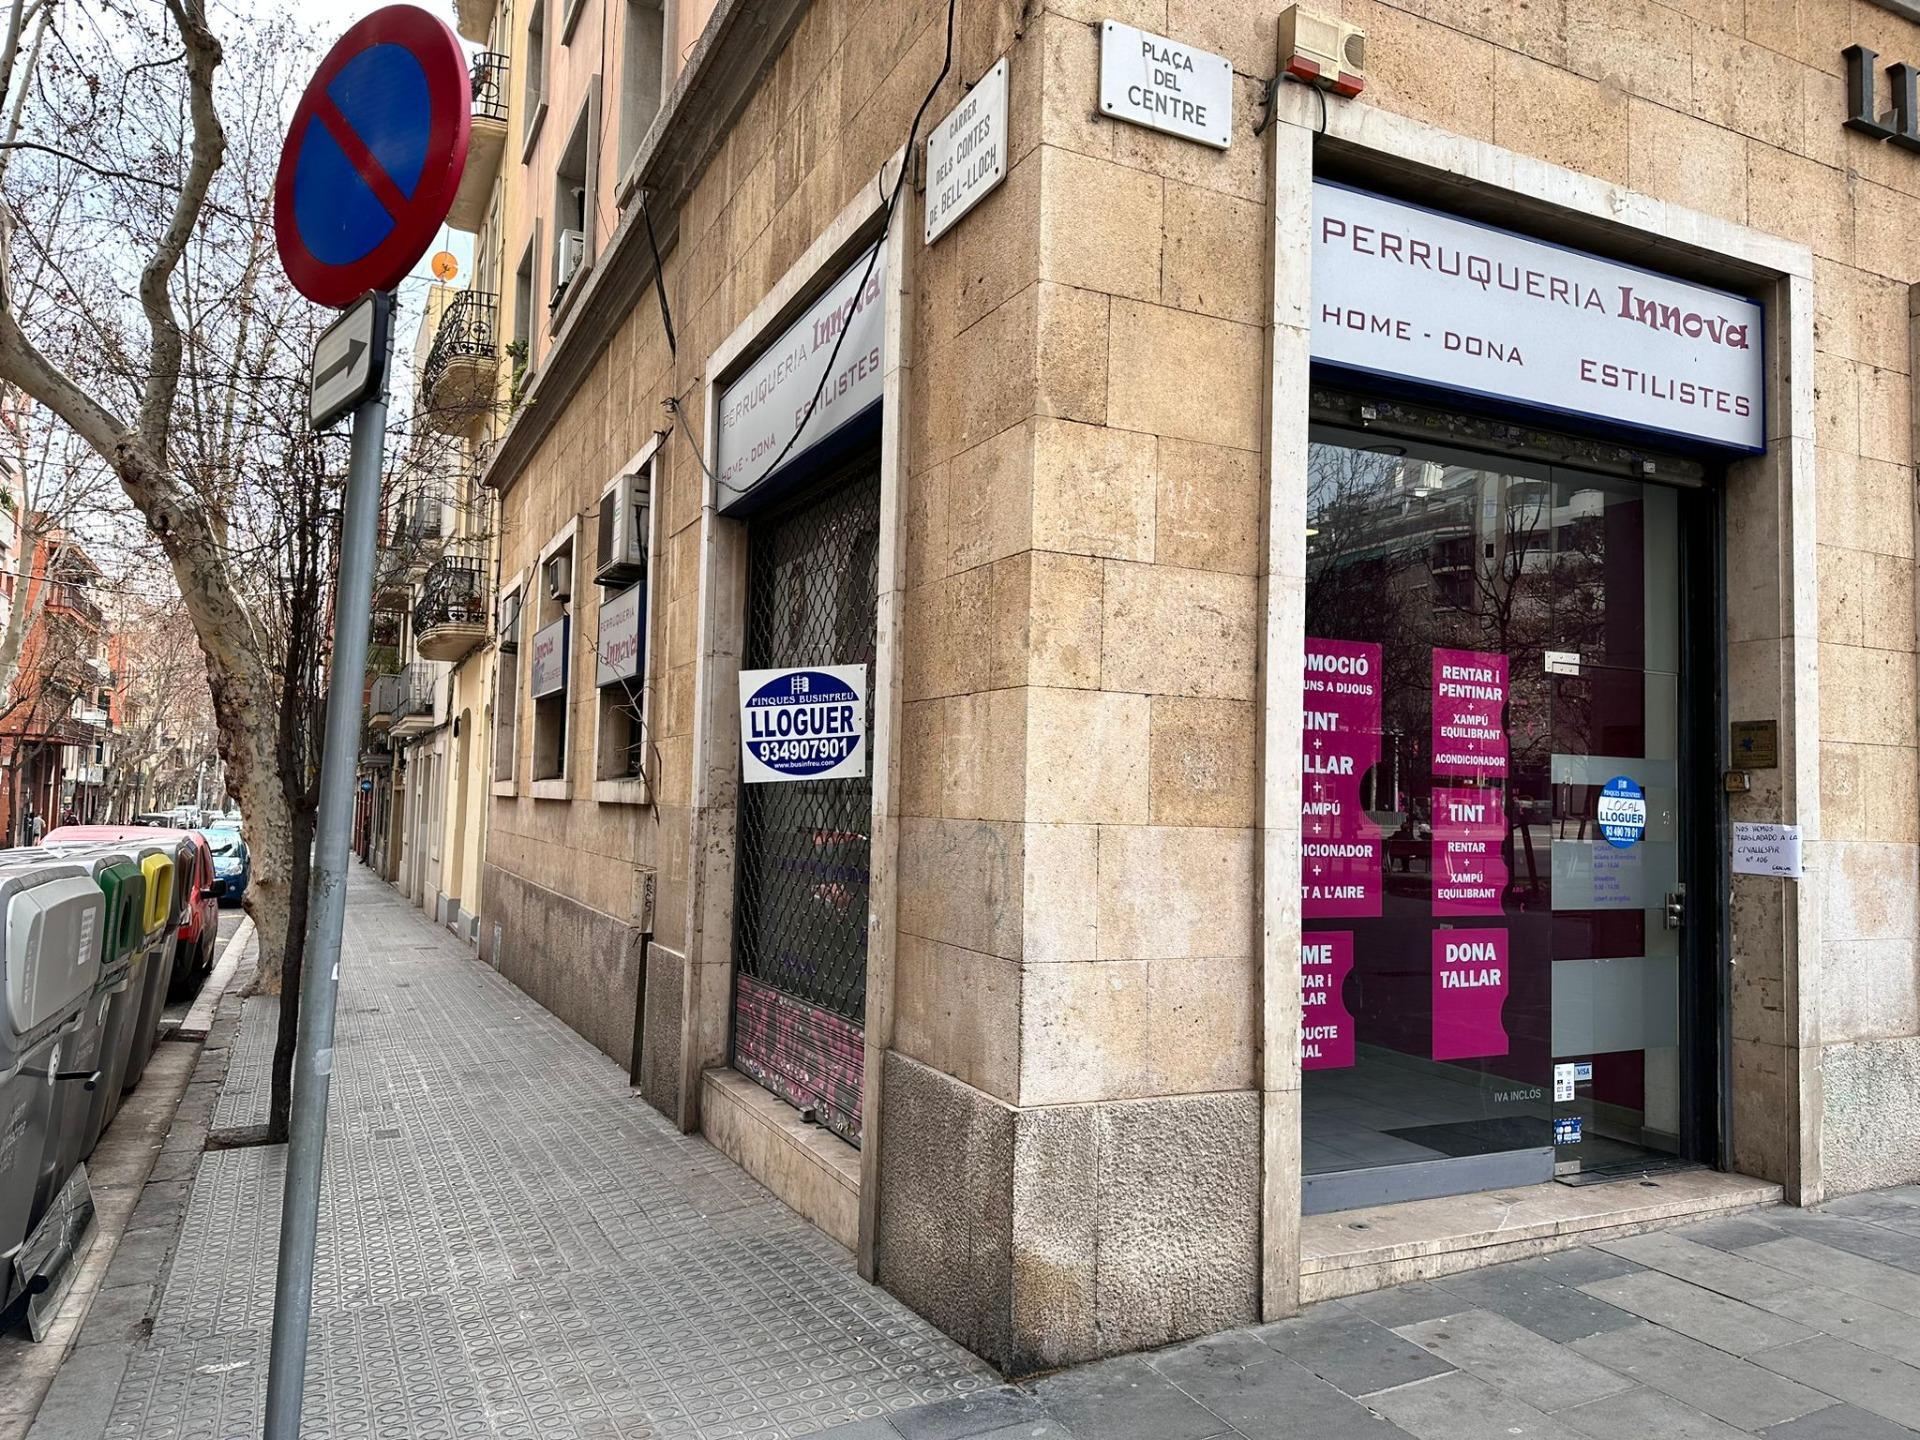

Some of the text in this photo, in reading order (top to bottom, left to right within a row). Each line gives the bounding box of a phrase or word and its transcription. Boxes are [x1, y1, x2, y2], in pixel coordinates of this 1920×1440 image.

[1141, 41, 1194, 73] PLAÇA
[1154, 69, 1182, 92] DEL
[1128, 85, 1207, 127] CENTRE
[949, 98, 977, 139] CARRER
[935, 114, 991, 186] DELS COMTES
[929, 143, 997, 226] DE BELL-LLOCH
[1322, 216, 1750, 350] PERRUQUERIA Innova
[1322, 303, 1411, 341] HOME
[1444, 331, 1523, 366] DONA
[722, 268, 881, 433] PERRUQUERIA Innova
[794, 346, 880, 429] ESTILISTES
[1580, 358, 1751, 417] ESTILISTES
[721, 458, 743, 482] HOME
[751, 432, 776, 461] DONA
[1442, 665, 1493, 683] RENTAR
[1326, 681, 1334, 692] A
[1336, 682, 1373, 696] DIJOUS
[1439, 683, 1502, 701] PENTINAR
[752, 692, 854, 706] FINQUES BUSINFREU
[751, 705, 854, 738] LLOGUER
[1453, 713, 1488, 726] XAMPÚ
[1441, 726, 1501, 740] EQUILIBRANT
[760, 738, 848, 762] 934907901
[1435, 753, 1506, 767] ACONDICIONADOR
[1448, 804, 1485, 823] TINT
[1607, 800, 1641, 812] LOCAL
[1600, 811, 1644, 824] LLOGUER
[1447, 842, 1486, 853] RENTAR
[1450, 871, 1483, 883] XAMPÚ
[1312, 886, 1321, 898] A
[1437, 888, 1496, 900] EQUILIBRANT
[1445, 943, 1497, 963] DONA
[1440, 968, 1501, 989] TALLAR
[1494, 1092, 1509, 1102] IVA
